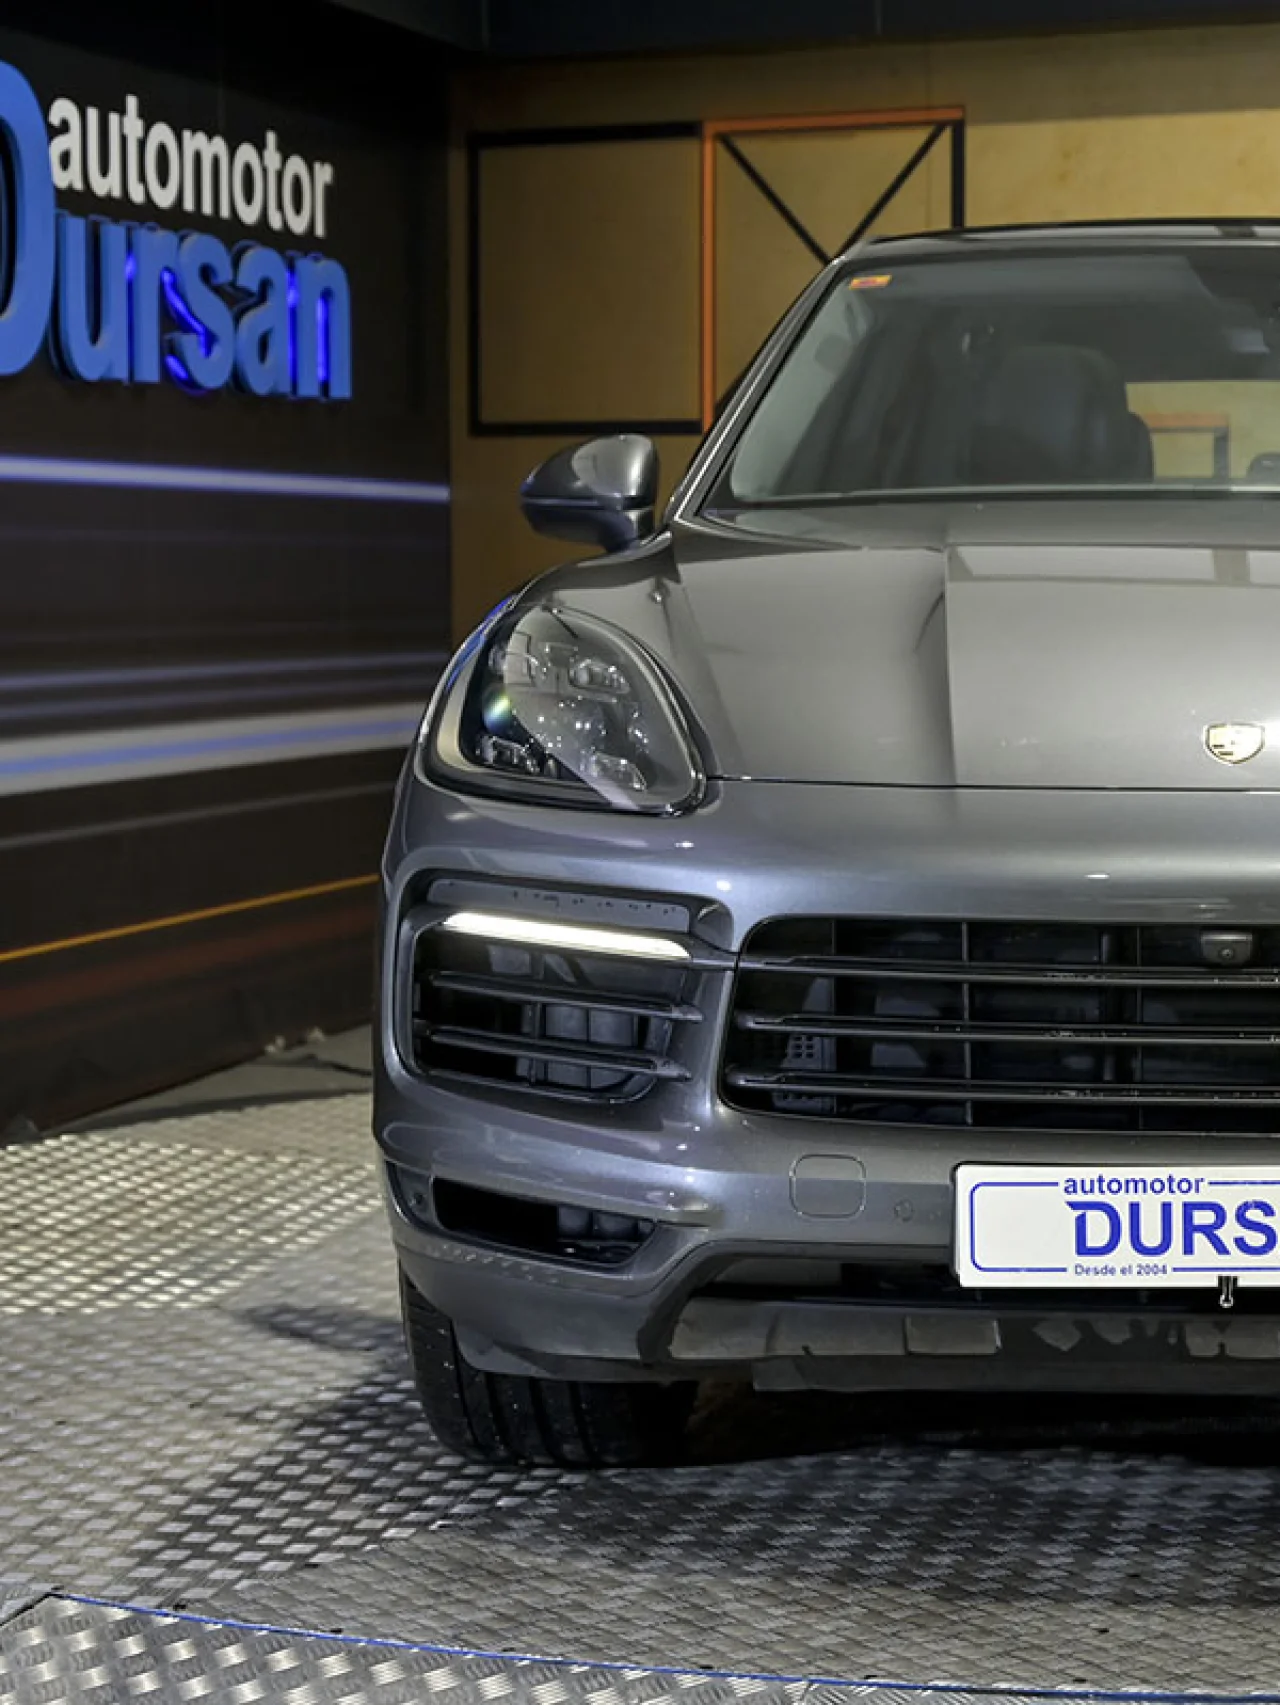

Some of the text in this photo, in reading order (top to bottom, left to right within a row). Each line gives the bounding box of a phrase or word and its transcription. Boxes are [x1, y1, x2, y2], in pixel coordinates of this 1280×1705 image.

[48, 94, 333, 238] automotor
[1064, 1174, 1205, 1195] automotor
[1074, 1263, 1168, 1276] Desde el 2004
